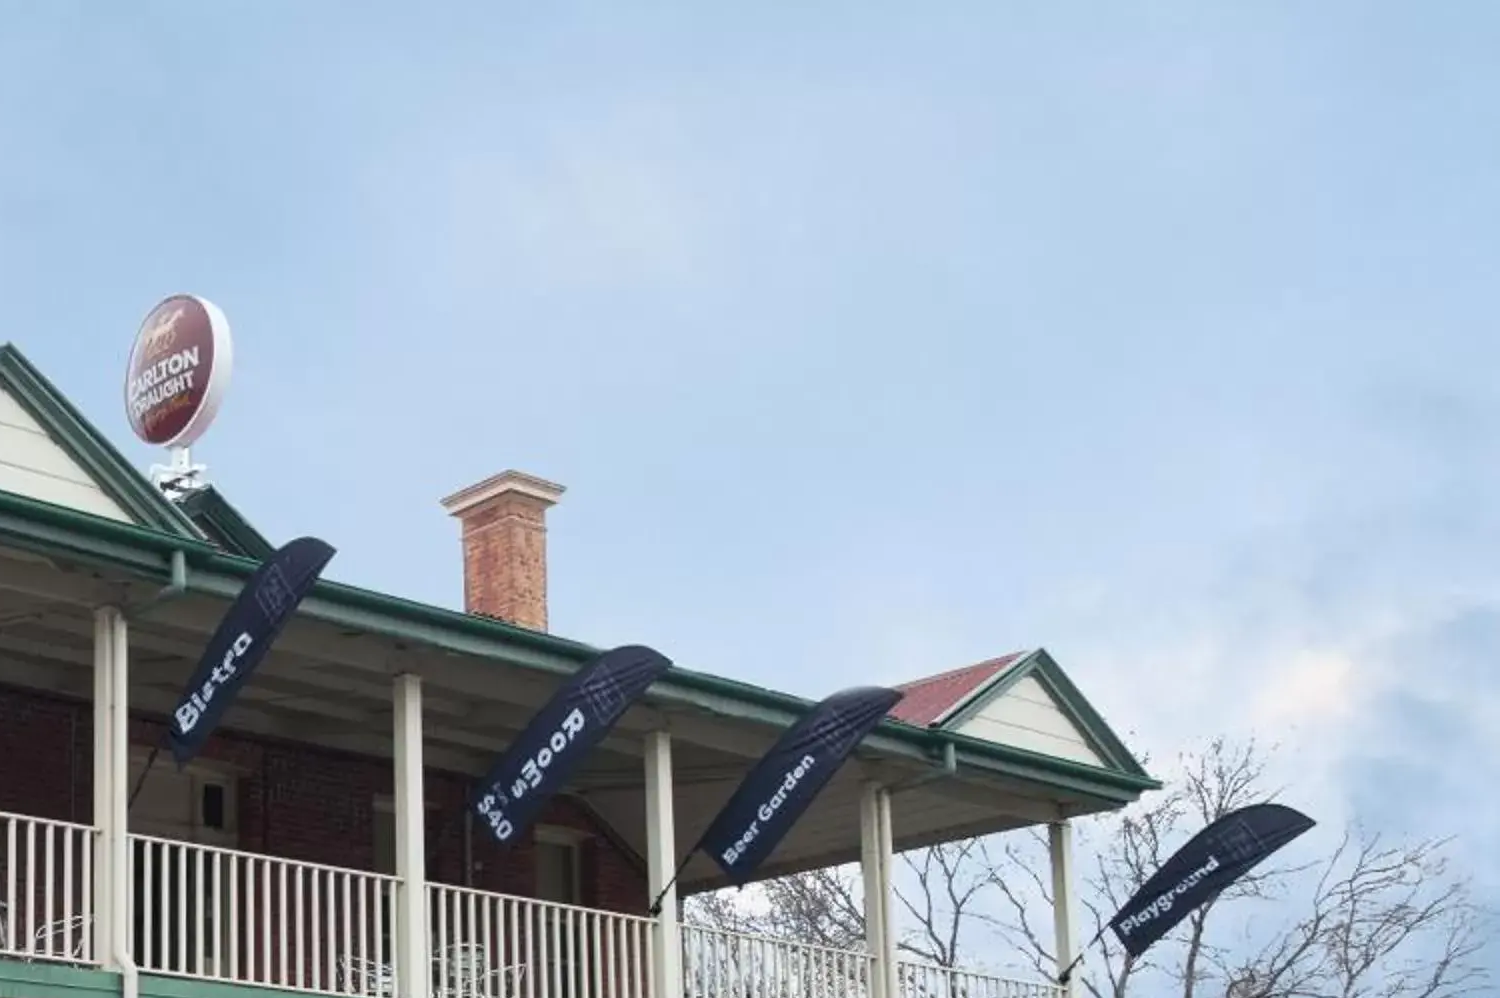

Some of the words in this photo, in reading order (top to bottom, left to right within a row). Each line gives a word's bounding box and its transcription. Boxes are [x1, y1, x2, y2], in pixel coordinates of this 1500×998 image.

[175, 632, 252, 734] Bistro
[722, 821, 760, 866] Beer
[757, 755, 816, 821] Garden
[1119, 855, 1220, 936] Playground
